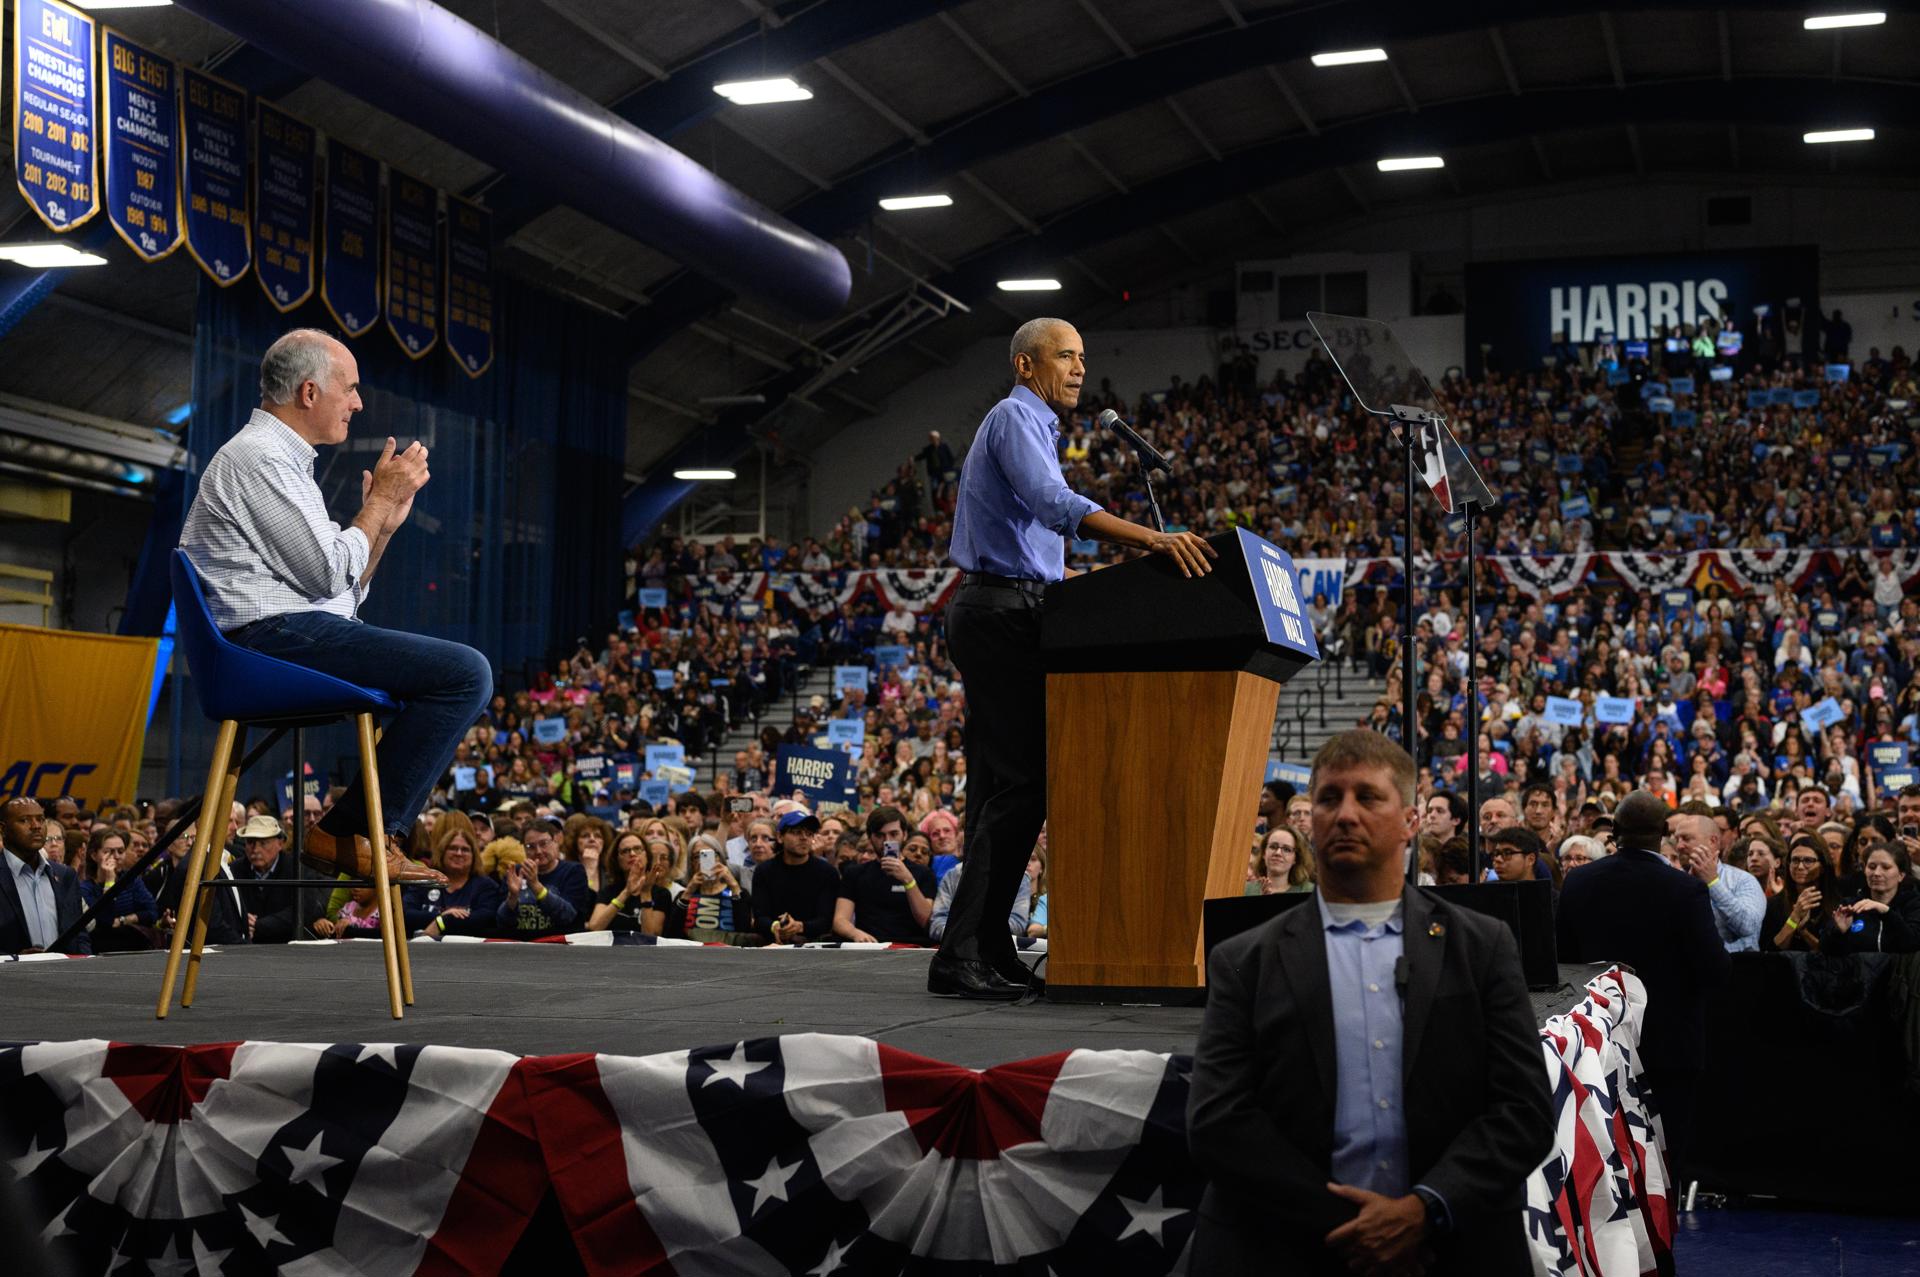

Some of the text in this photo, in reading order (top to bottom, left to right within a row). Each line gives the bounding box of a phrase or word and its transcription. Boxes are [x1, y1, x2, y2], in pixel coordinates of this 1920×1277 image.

[43, 8, 72, 47] EWL
[113, 44, 167, 90] BIG EAST
[24, 91, 58, 115] REGULAR
[128, 91, 156, 114] MEN'S
[128, 105, 158, 130] TRACK
[117, 116, 170, 149] CHAMPIONS
[192, 147, 241, 177] CHAMPIONS
[1550, 279, 1728, 343] HARRIS
[1260, 557, 1301, 617] HARRIS
[1280, 612, 1306, 646] WALZ
[787, 756, 834, 780] HARRIS
[792, 773, 825, 789] WALZ
